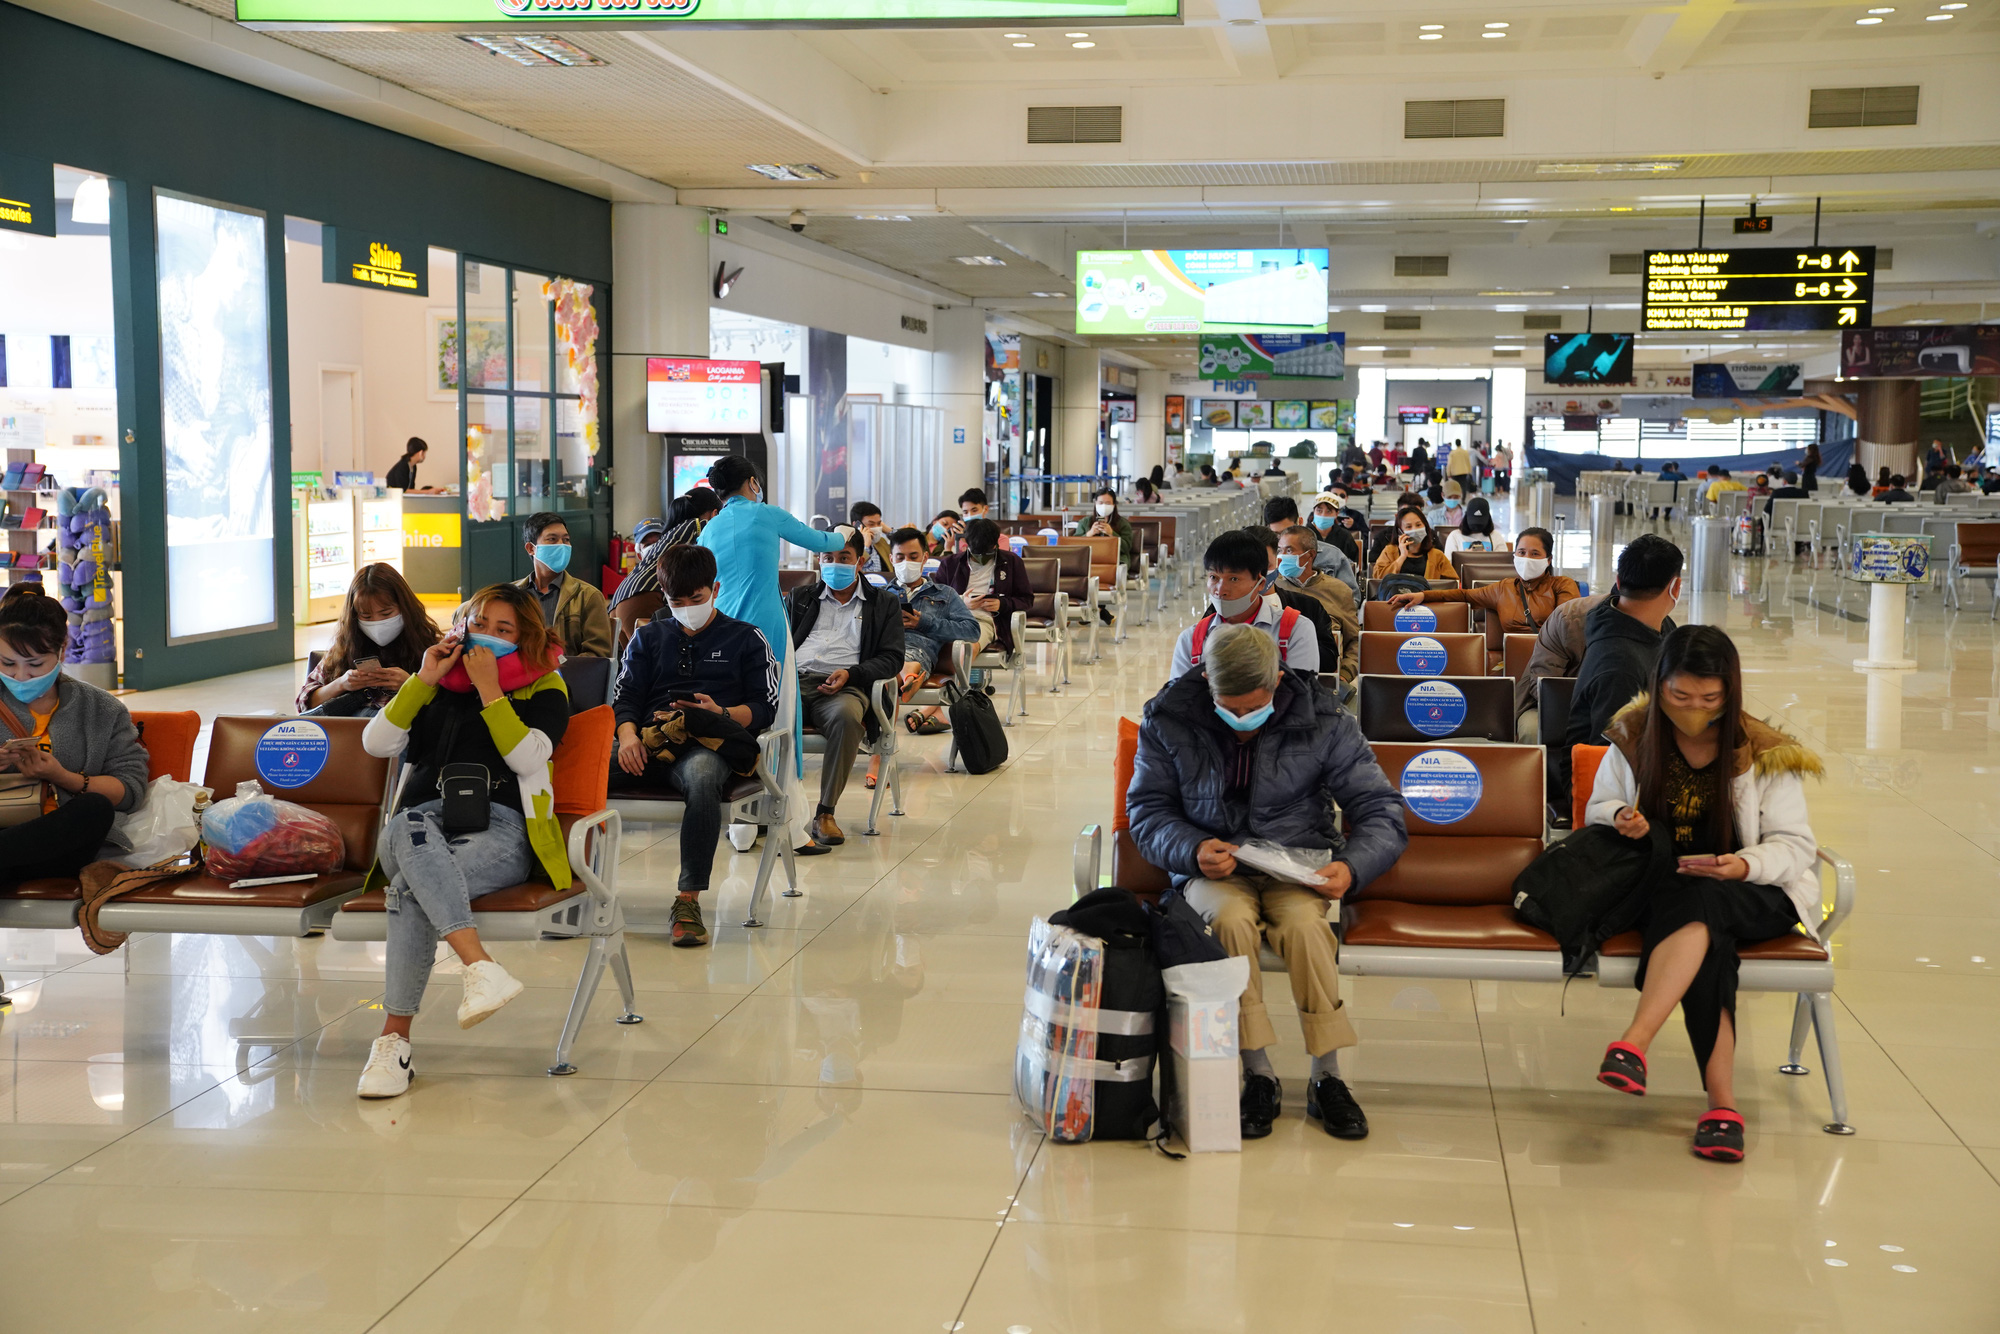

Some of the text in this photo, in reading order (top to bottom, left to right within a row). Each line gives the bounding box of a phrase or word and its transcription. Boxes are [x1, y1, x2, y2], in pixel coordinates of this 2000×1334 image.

[1743, 219, 1767, 230] 14:15
[370, 242, 402, 270] Shine
[1649, 252, 1729, 264] CỬA RA TÀU BAY
[1649, 265, 1718, 276] Boarding Gates
[1648, 279, 1728, 291] CỬA RA TÀU BAY
[1648, 292, 1717, 302] Boarding Gates
[1647, 308, 1668, 318] KHU
[1669, 308, 1685, 318] VUI
[1686, 308, 1711, 318] CHƠI
[1733, 308, 1748, 317] EM
[1647, 318, 1746, 329] Children's Playground
[1436, 407, 1444, 419] 7
[403, 530, 443, 547] hine
[93, 525, 104, 589] Travel Blue
